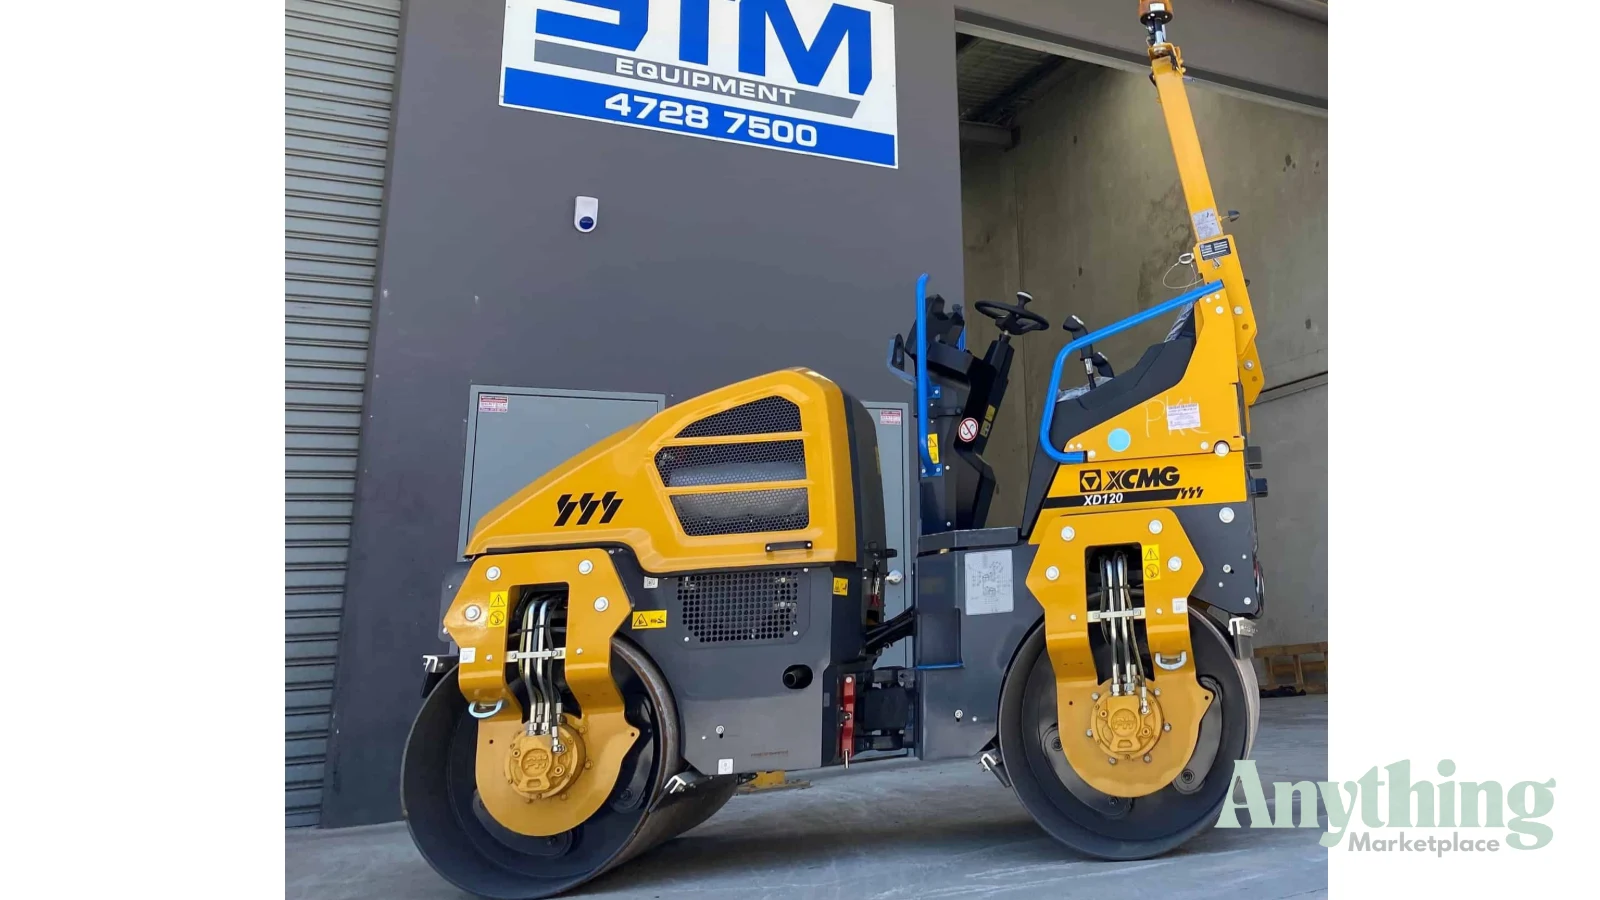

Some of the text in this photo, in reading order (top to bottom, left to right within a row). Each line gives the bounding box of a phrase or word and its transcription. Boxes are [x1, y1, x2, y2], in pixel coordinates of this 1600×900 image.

[616, 57, 796, 105] EQUIPMENT
[605, 93, 818, 148] 4728 7500
[1103, 466, 1180, 491] XCMG
[1083, 493, 1124, 506] XD120
